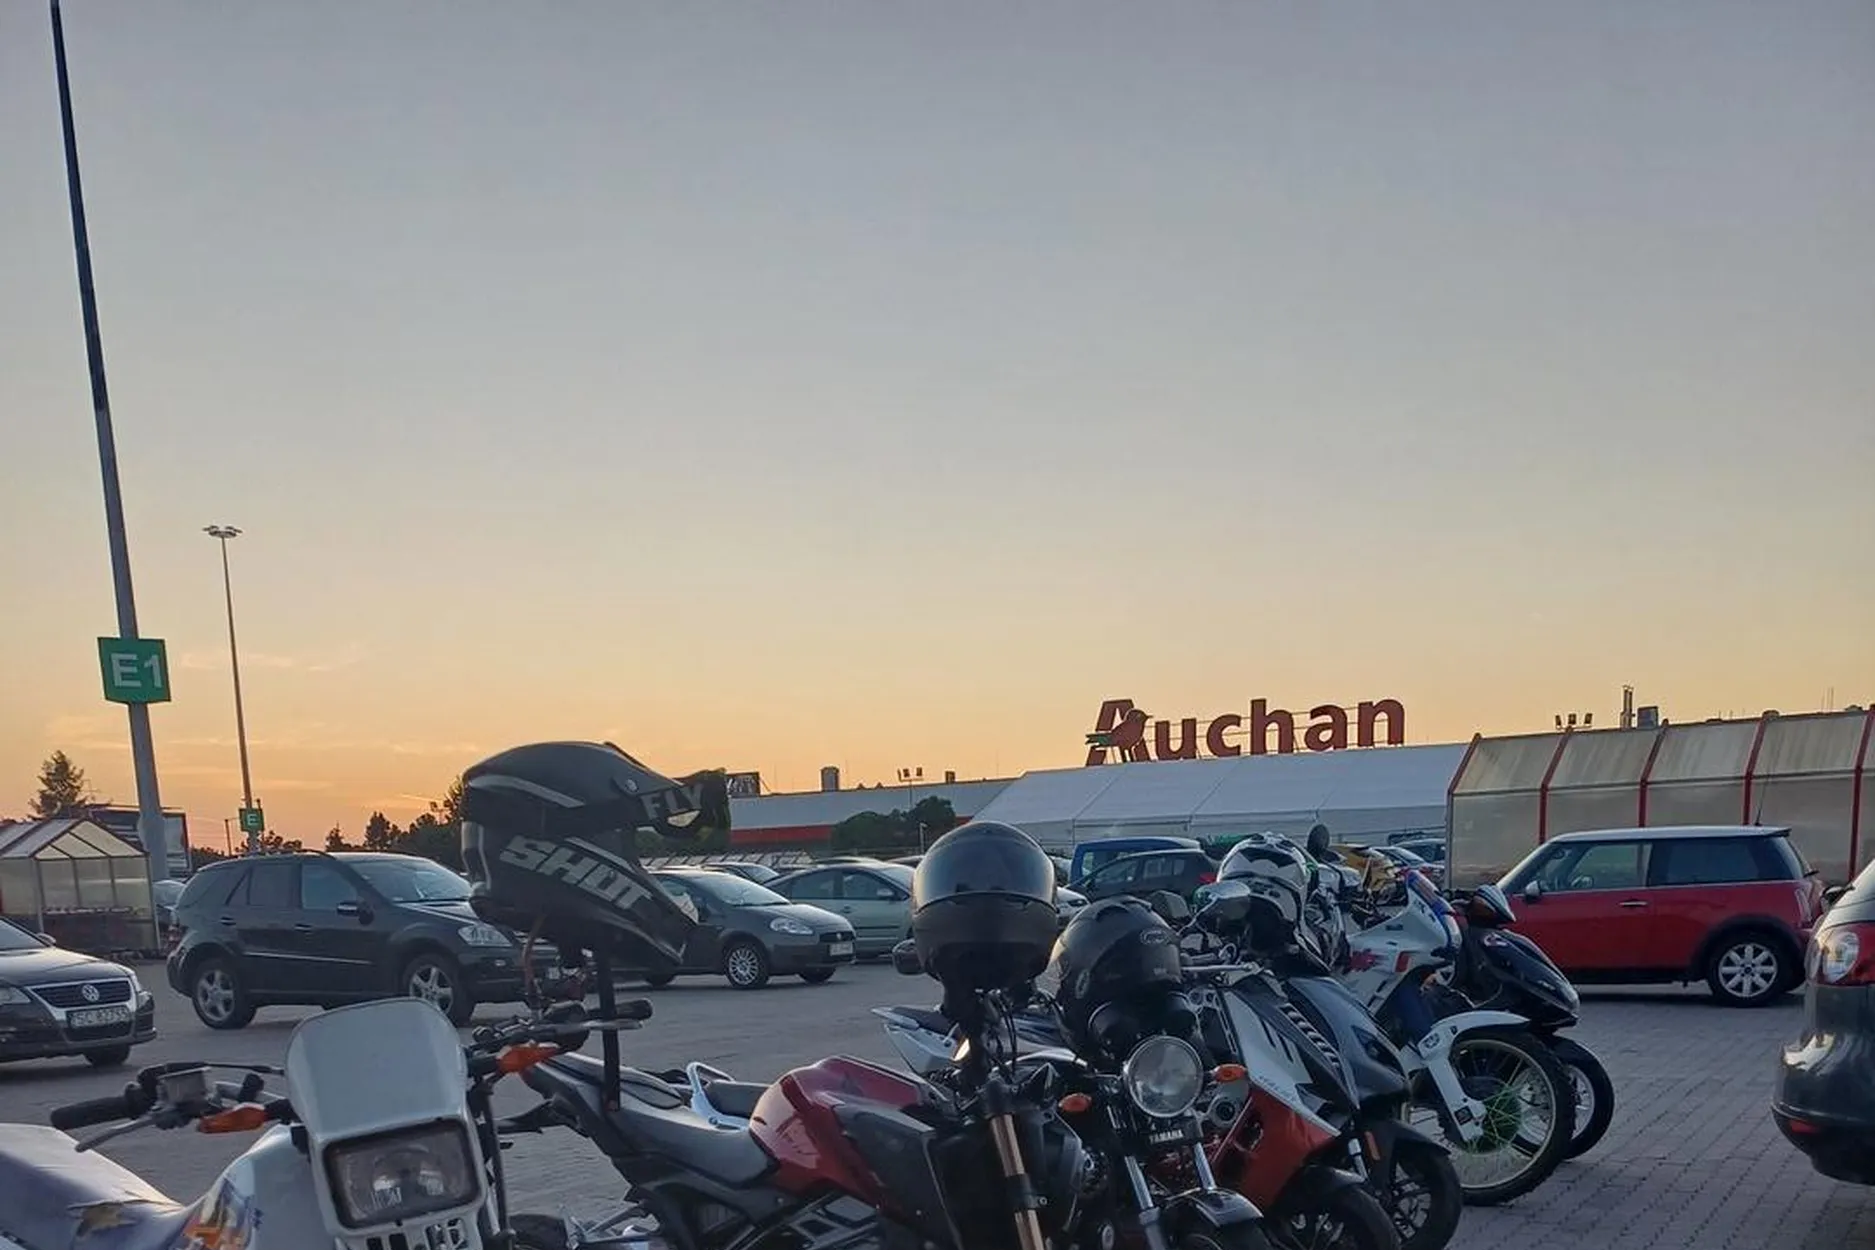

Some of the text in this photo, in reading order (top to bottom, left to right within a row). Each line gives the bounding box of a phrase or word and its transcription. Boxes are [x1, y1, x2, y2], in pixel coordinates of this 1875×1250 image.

[111, 653, 164, 689] E1
[1086, 698, 1405, 767] Auchan
[640, 782, 704, 821] FLY
[500, 834, 653, 910] SHOT
[1149, 1129, 1184, 1145] YAMAHA
